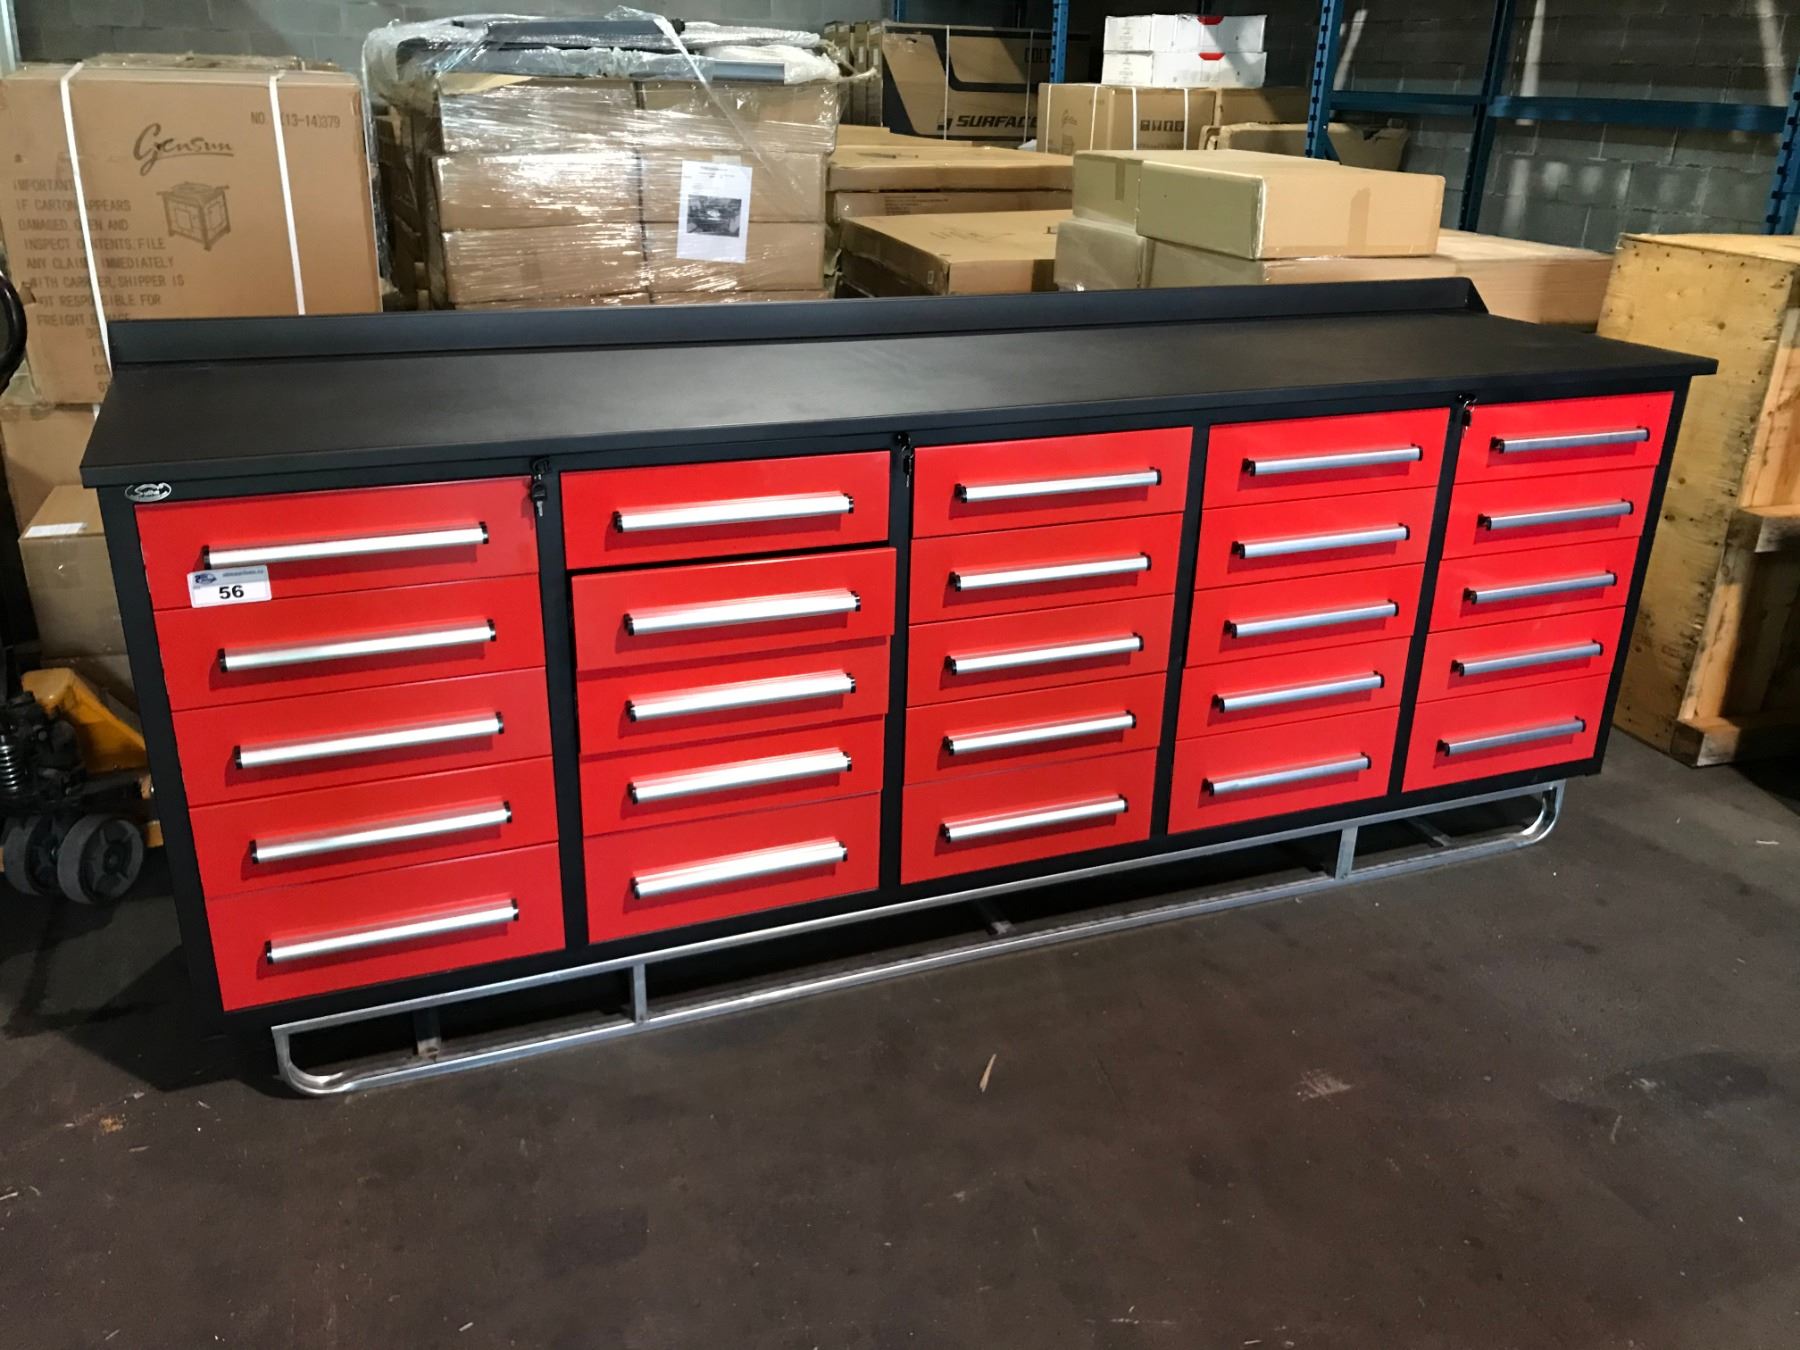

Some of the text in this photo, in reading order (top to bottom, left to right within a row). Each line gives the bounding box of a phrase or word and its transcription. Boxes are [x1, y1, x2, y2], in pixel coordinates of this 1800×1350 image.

[138, 236, 166, 250] FILE
[101, 255, 174, 270] IMMEDIATELY
[172, 272, 185, 287] IS
[218, 584, 245, 600] 56
